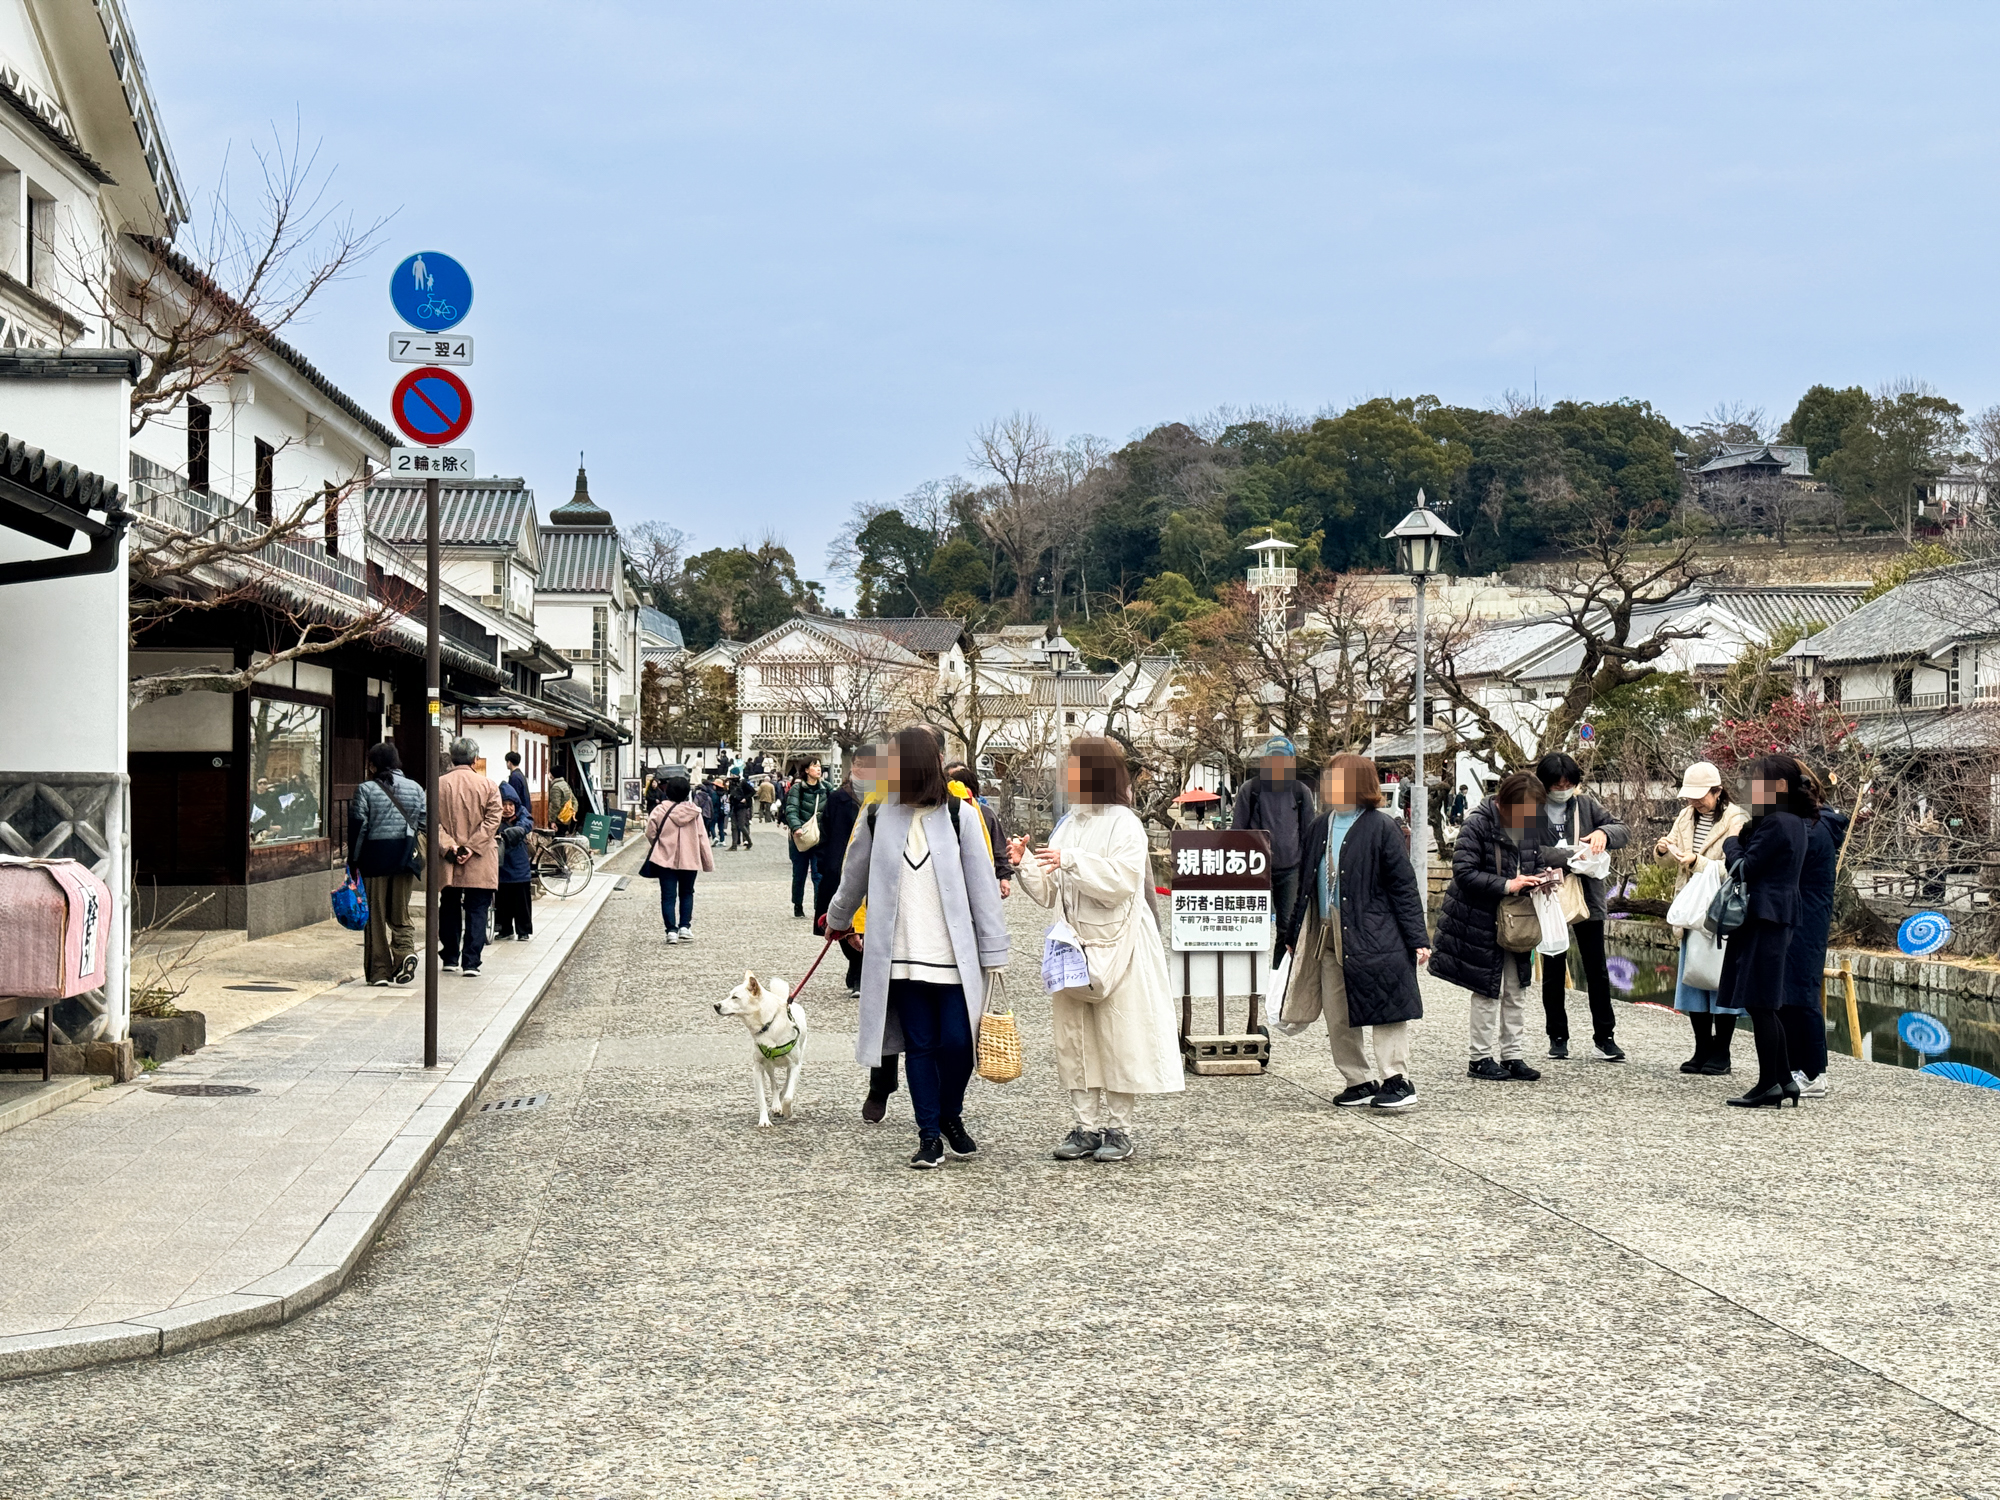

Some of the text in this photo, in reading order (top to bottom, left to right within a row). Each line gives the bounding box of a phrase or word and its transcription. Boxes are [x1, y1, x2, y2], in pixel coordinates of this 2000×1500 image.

[398, 455, 468, 472] 2輪を除く
[1177, 849, 1266, 875] 規制あり
[1175, 895, 1267, 911] 歩行者・自転車専用
